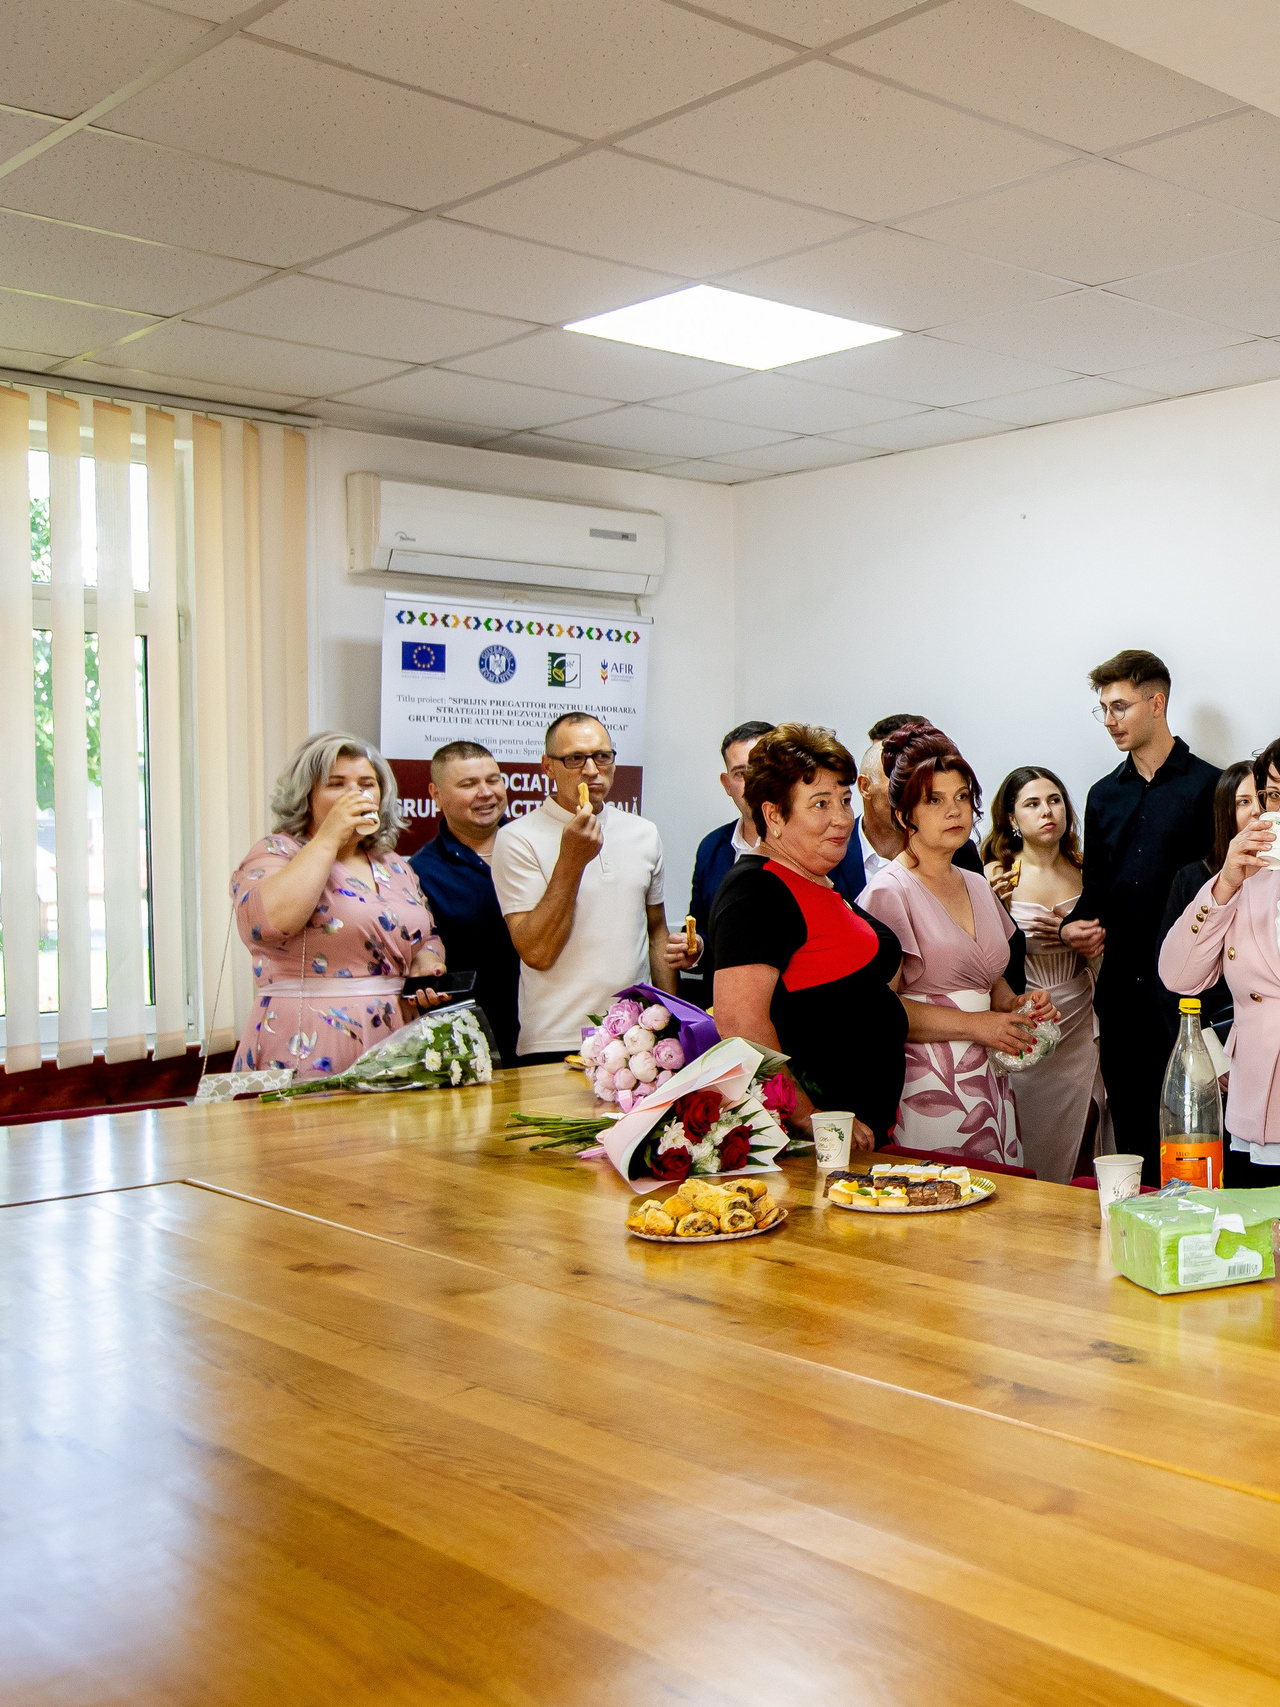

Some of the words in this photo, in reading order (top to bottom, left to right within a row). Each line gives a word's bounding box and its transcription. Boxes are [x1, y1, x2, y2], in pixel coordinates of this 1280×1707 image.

[611, 662, 634, 675] AFIR
[397, 694, 415, 703] Titlu
[490, 699, 547, 709] PREGATITOR
[549, 703, 583, 711] PENTRU
[585, 705, 637, 714] ELABORAREA
[436, 706, 490, 716] STRATEGIEI
[492, 709, 505, 717] DE
[408, 714, 459, 724] GRUPULUI
[461, 717, 473, 725] DE
[475, 718, 515, 727] ACTIUNE
